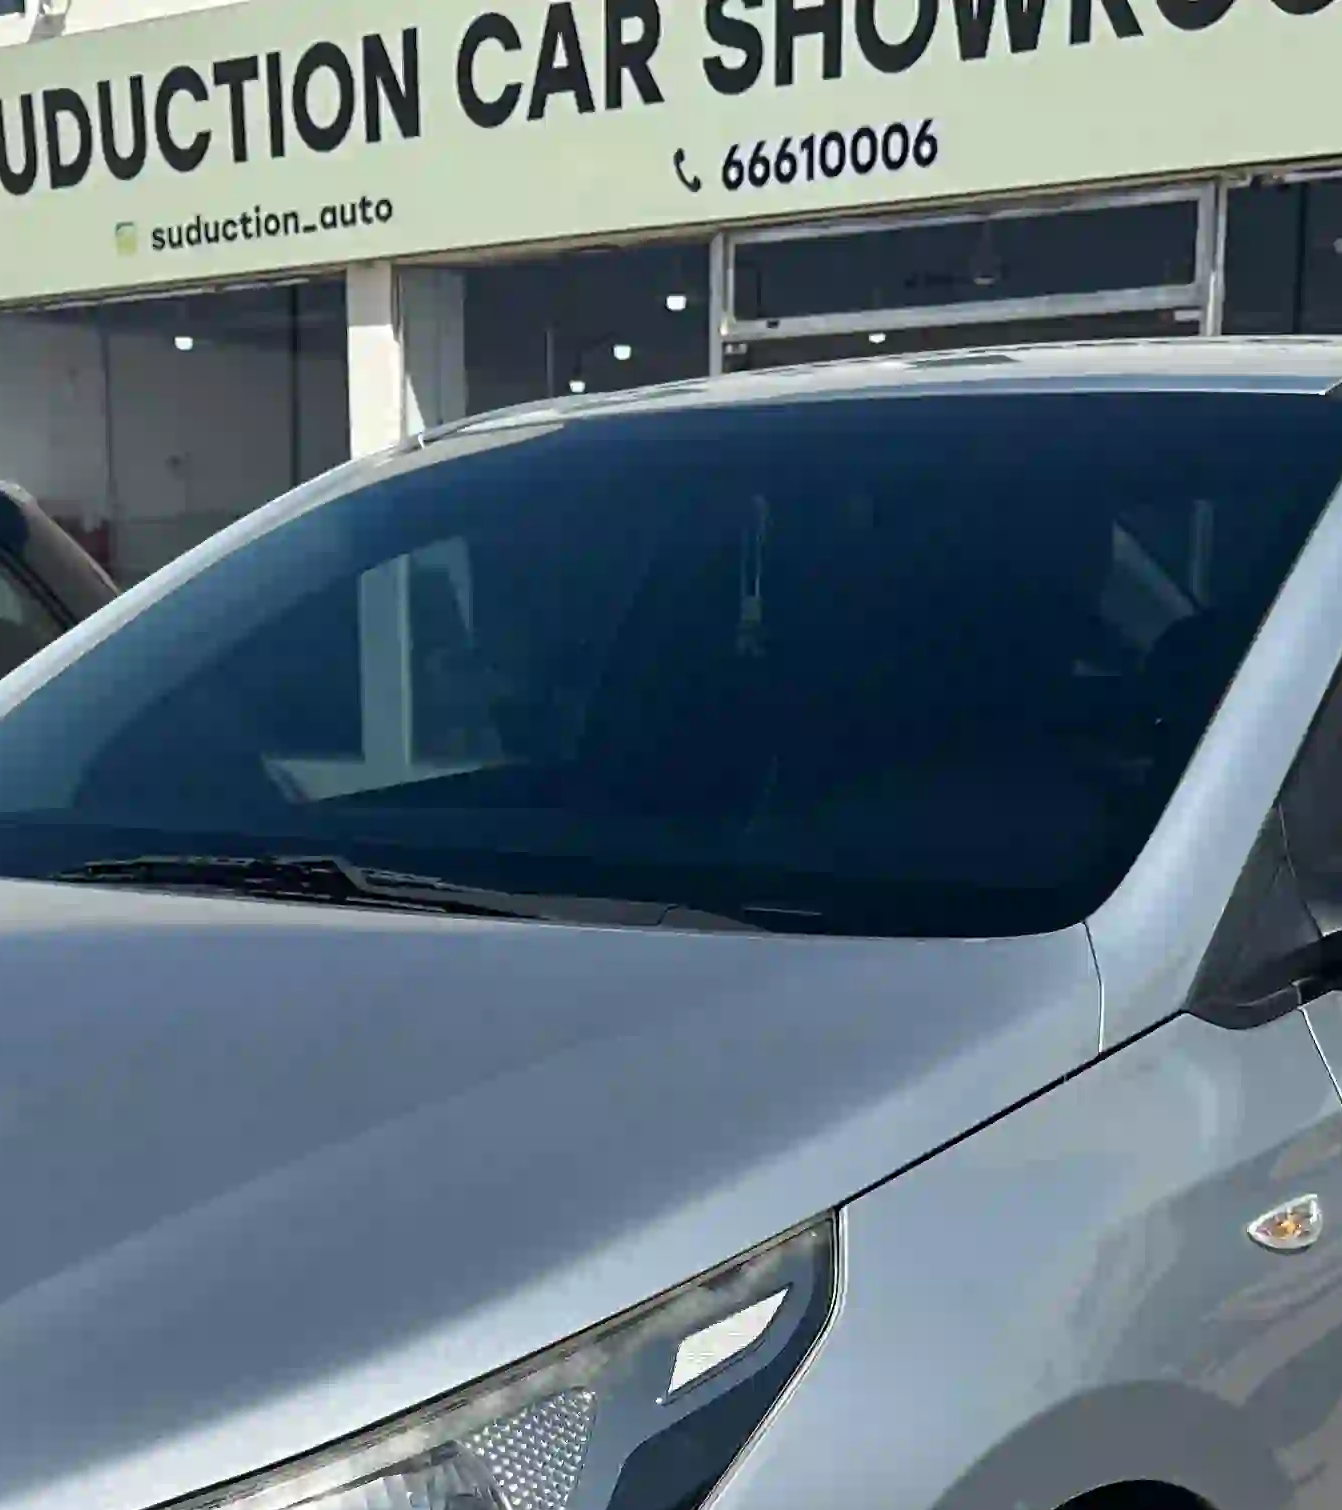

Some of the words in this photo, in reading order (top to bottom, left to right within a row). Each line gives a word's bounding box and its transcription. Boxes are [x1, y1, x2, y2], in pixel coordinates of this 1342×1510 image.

[456, 0, 664, 129] CAR
[720, 117, 939, 192] 66610006
[150, 195, 394, 252] suduction_auto
